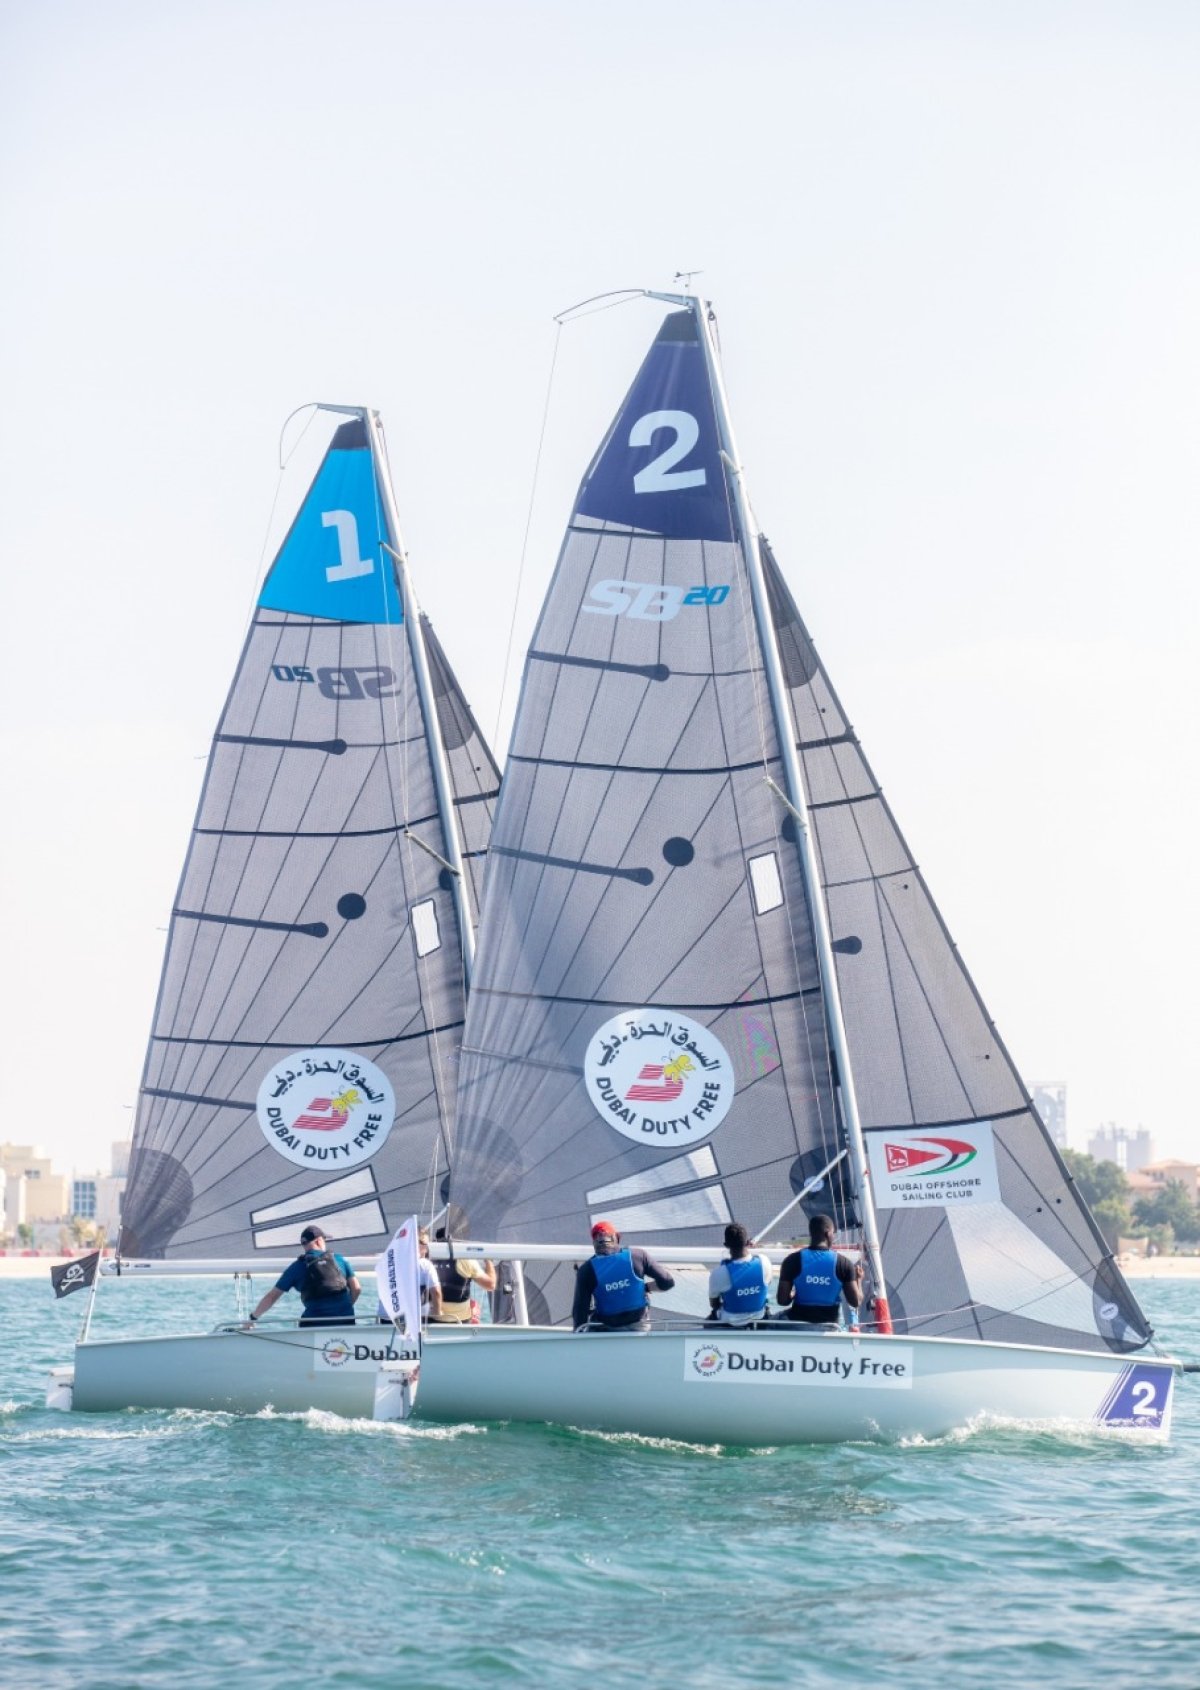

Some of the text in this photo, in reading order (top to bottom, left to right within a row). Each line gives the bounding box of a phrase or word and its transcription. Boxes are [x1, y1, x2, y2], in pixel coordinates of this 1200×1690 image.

[628, 409, 707, 495] 2
[320, 508, 375, 583] 1
[596, 1076, 721, 1135] DUBAI DUTY FREE
[267, 1107, 383, 1160] DUBAI DUTY FREE
[890, 1178, 982, 1192] DUBAI OFFSHORE
[902, 1189, 973, 1201] SAILING CLUB
[605, 1278, 631, 1292] DOSC
[736, 1285, 761, 1297] DOSC
[805, 1274, 831, 1286] DOSC
[354, 1344, 418, 1361] Dubai
[727, 1351, 794, 1373] Dubai
[801, 1355, 853, 1379] Duty
[859, 1357, 906, 1377] Free
[1131, 1381, 1158, 1416] 2
